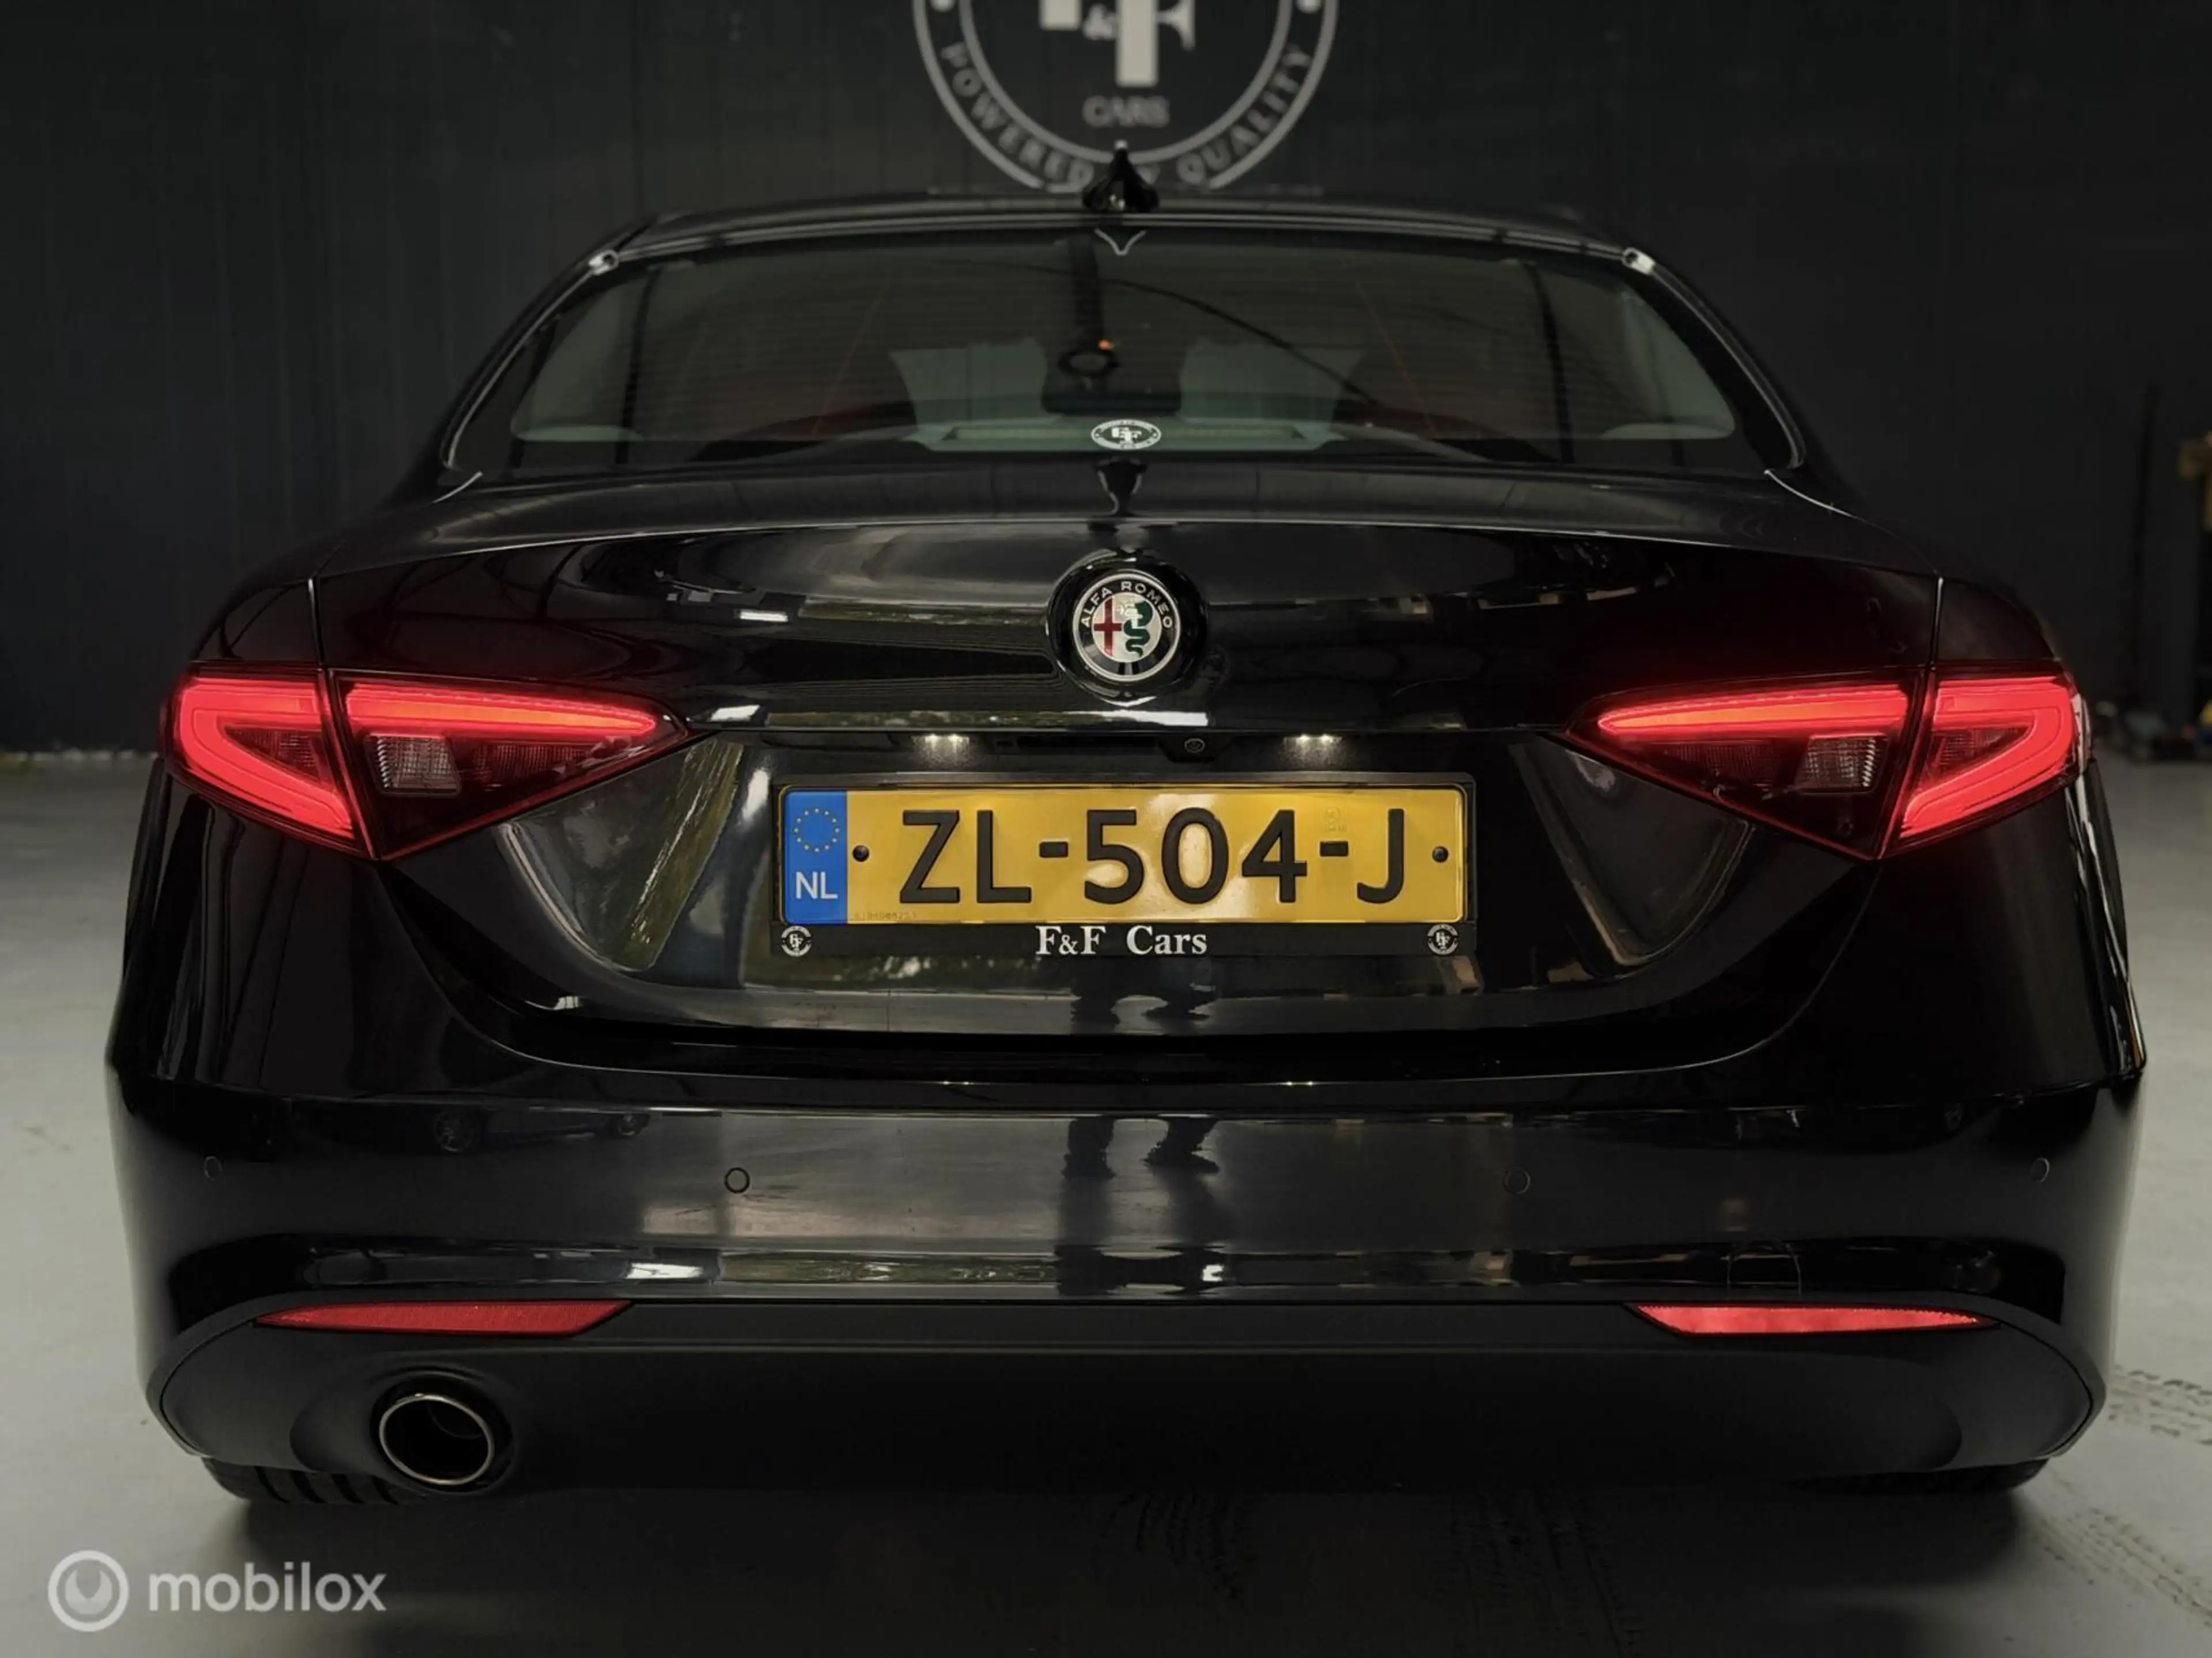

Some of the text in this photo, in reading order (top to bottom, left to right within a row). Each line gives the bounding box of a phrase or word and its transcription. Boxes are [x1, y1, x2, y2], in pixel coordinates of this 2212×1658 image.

[940, 41, 1094, 185] POWERED
[1176, 43, 1311, 185] QUALITY
[1082, 94, 1170, 128] CARS
[1081, 581, 1173, 628] ALFA ROMEO
[899, 807, 1405, 904] ZL-504-J
[796, 871, 838, 899] NL
[1035, 925, 1207, 955] F&F Cars
